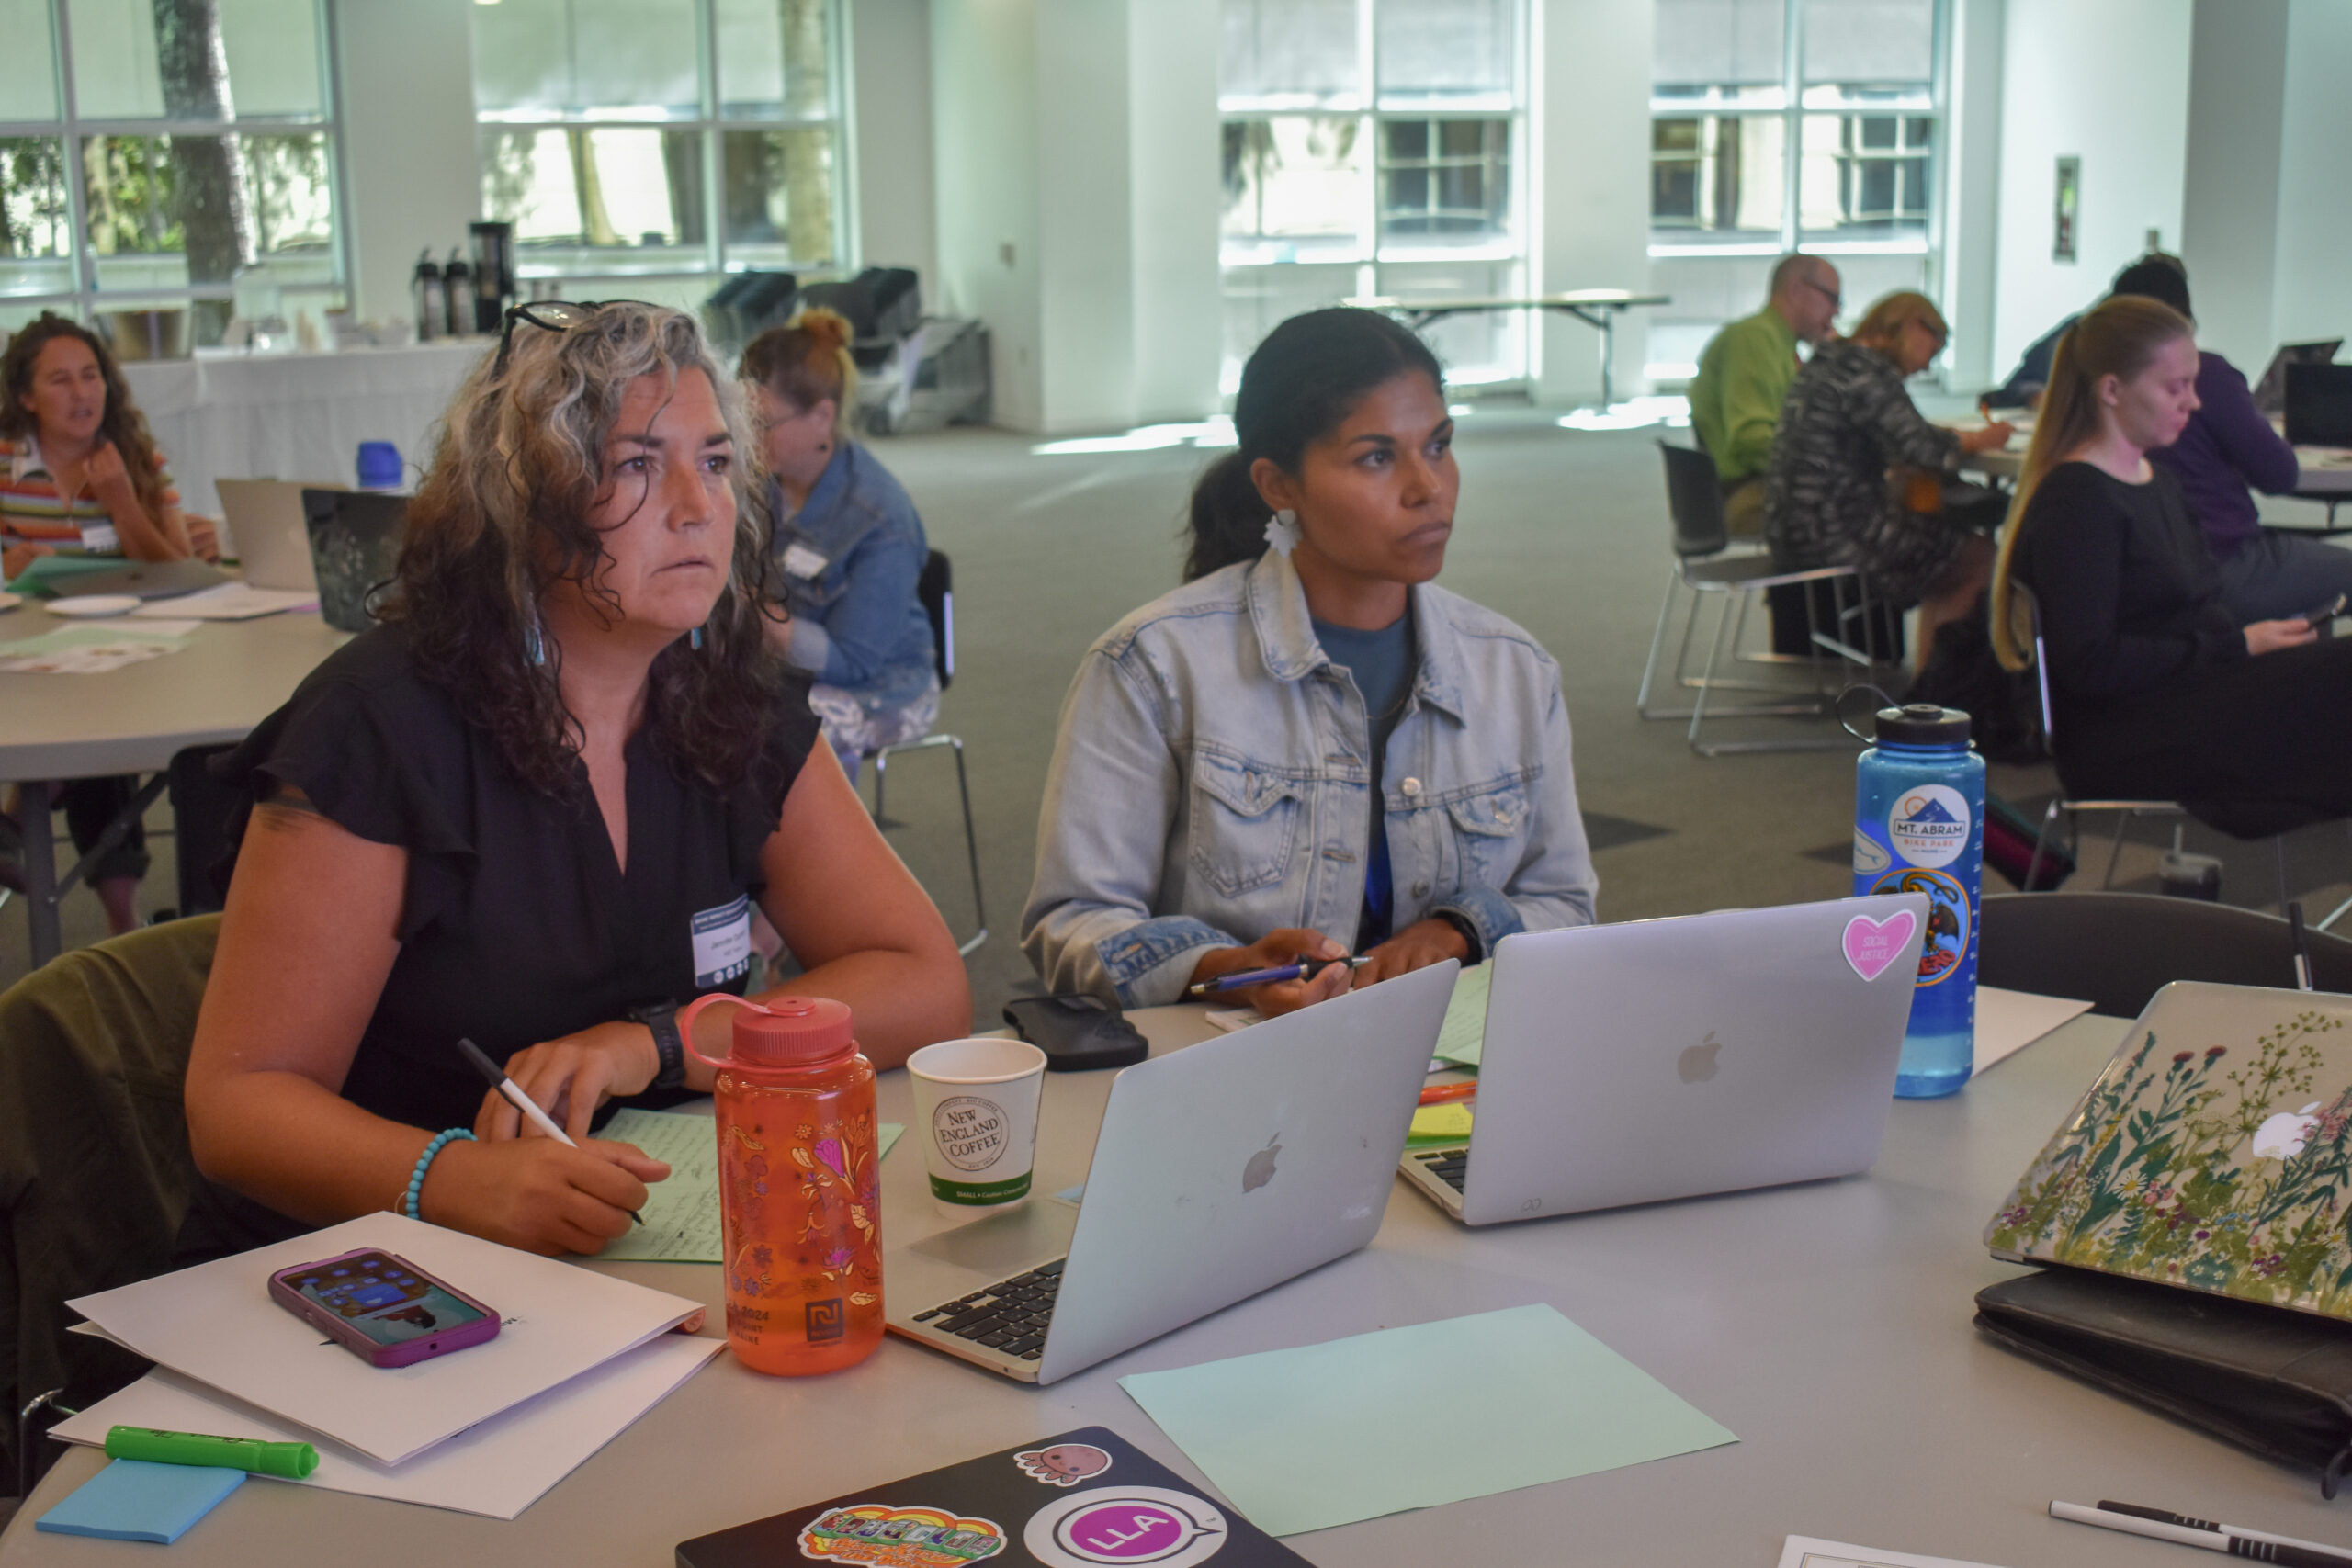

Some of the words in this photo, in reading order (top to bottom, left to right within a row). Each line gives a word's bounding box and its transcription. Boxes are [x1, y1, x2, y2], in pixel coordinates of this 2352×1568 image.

[1896, 823, 1917, 834] MT.
[1920, 825, 1962, 835] ABRAM
[1904, 839, 1927, 847] BIKE
[1862, 935, 1889, 947] SOCIAL
[1858, 948, 1889, 961] JUSTICE
[947, 1109, 976, 1126] NEW
[940, 1118, 999, 1143] ENGLAND
[949, 1132, 1001, 1157] COFFEE
[741, 1305, 770, 1322] 2024
[812, 1514, 1001, 1556] EDUCOLOR
[1087, 1515, 1169, 1551] LLA
